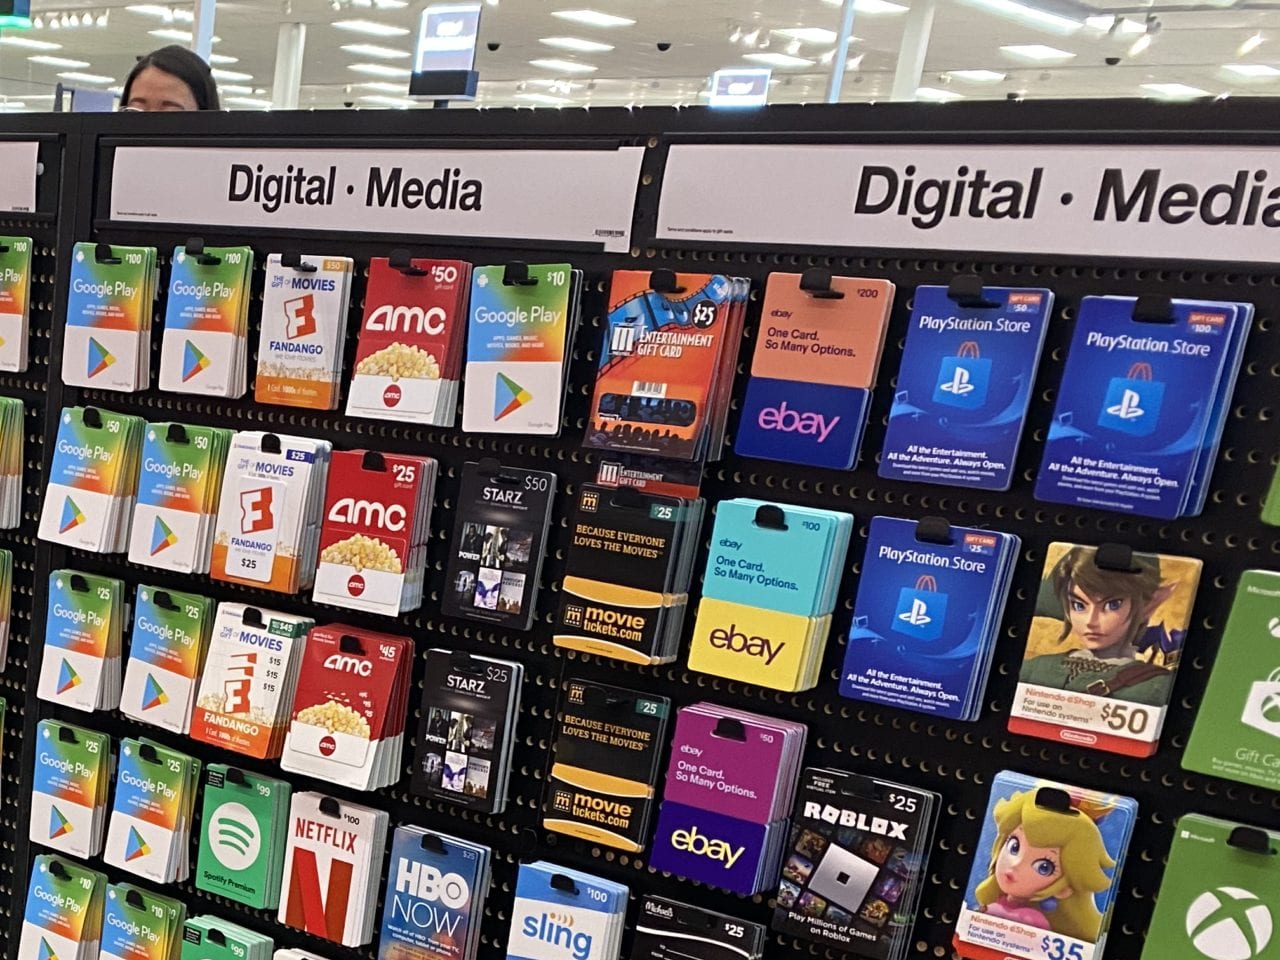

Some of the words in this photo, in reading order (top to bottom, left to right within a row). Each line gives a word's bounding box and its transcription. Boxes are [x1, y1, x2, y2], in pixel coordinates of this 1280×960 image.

[227, 163, 336, 213] Digital
[365, 166, 483, 211] Media
[854, 165, 1045, 229] Digital
[1093, 167, 1280, 226] Media
[4, 268, 23, 285] Play
[431, 266, 458, 283] $50
[547, 272, 565, 286] $10
[856, 288, 879, 298] $200
[365, 304, 447, 335] amc
[474, 307, 528, 328] Google
[530, 306, 561, 327] Play
[694, 304, 715, 325] $25
[770, 309, 793, 320] ebay
[767, 327, 789, 340] One
[790, 329, 820, 342] Card.
[1086, 331, 1169, 354] PlayStation
[1172, 338, 1211, 357] Store
[637, 342, 659, 356] GIFT
[659, 344, 683, 358] CARD
[764, 338, 779, 350] So
[780, 339, 810, 355] Many
[811, 343, 856, 358] Options.
[758, 402, 840, 443] ebay
[255, 461, 295, 477] MOVIES
[524, 475, 548, 492] $50
[482, 487, 523, 504] STARZ
[231, 537, 273, 552] FANDANGO
[576, 525, 616, 540] BECAUSE
[617, 530, 666, 548] EVERYONE
[574, 536, 603, 549] LOVES
[604, 540, 622, 551] THE
[623, 543, 659, 559] MOVIES
[241, 558, 257, 569] $25
[584, 606, 645, 630] movie
[583, 621, 643, 642] tickets.com
[709, 624, 786, 666] ebay
[1100, 702, 1149, 735] $50
[256, 784, 271, 797] $99
[889, 792, 917, 813] $25
[344, 812, 360, 825] $100
[804, 801, 910, 841] ROBLOX
[295, 817, 358, 855] NETFLIX
[203, 871, 227, 888] Spotify
[395, 857, 469, 910] HBO
[587, 887, 608, 903] $100
[391, 894, 461, 938] NOW
[521, 910, 593, 960] sling
[724, 923, 745, 938] $25
[788, 912, 805, 924] Play
[806, 915, 838, 931] Millions
[839, 923, 849, 933] of
[848, 926, 877, 942] Games
[810, 926, 820, 935] on
[821, 928, 851, 944] Roblox
